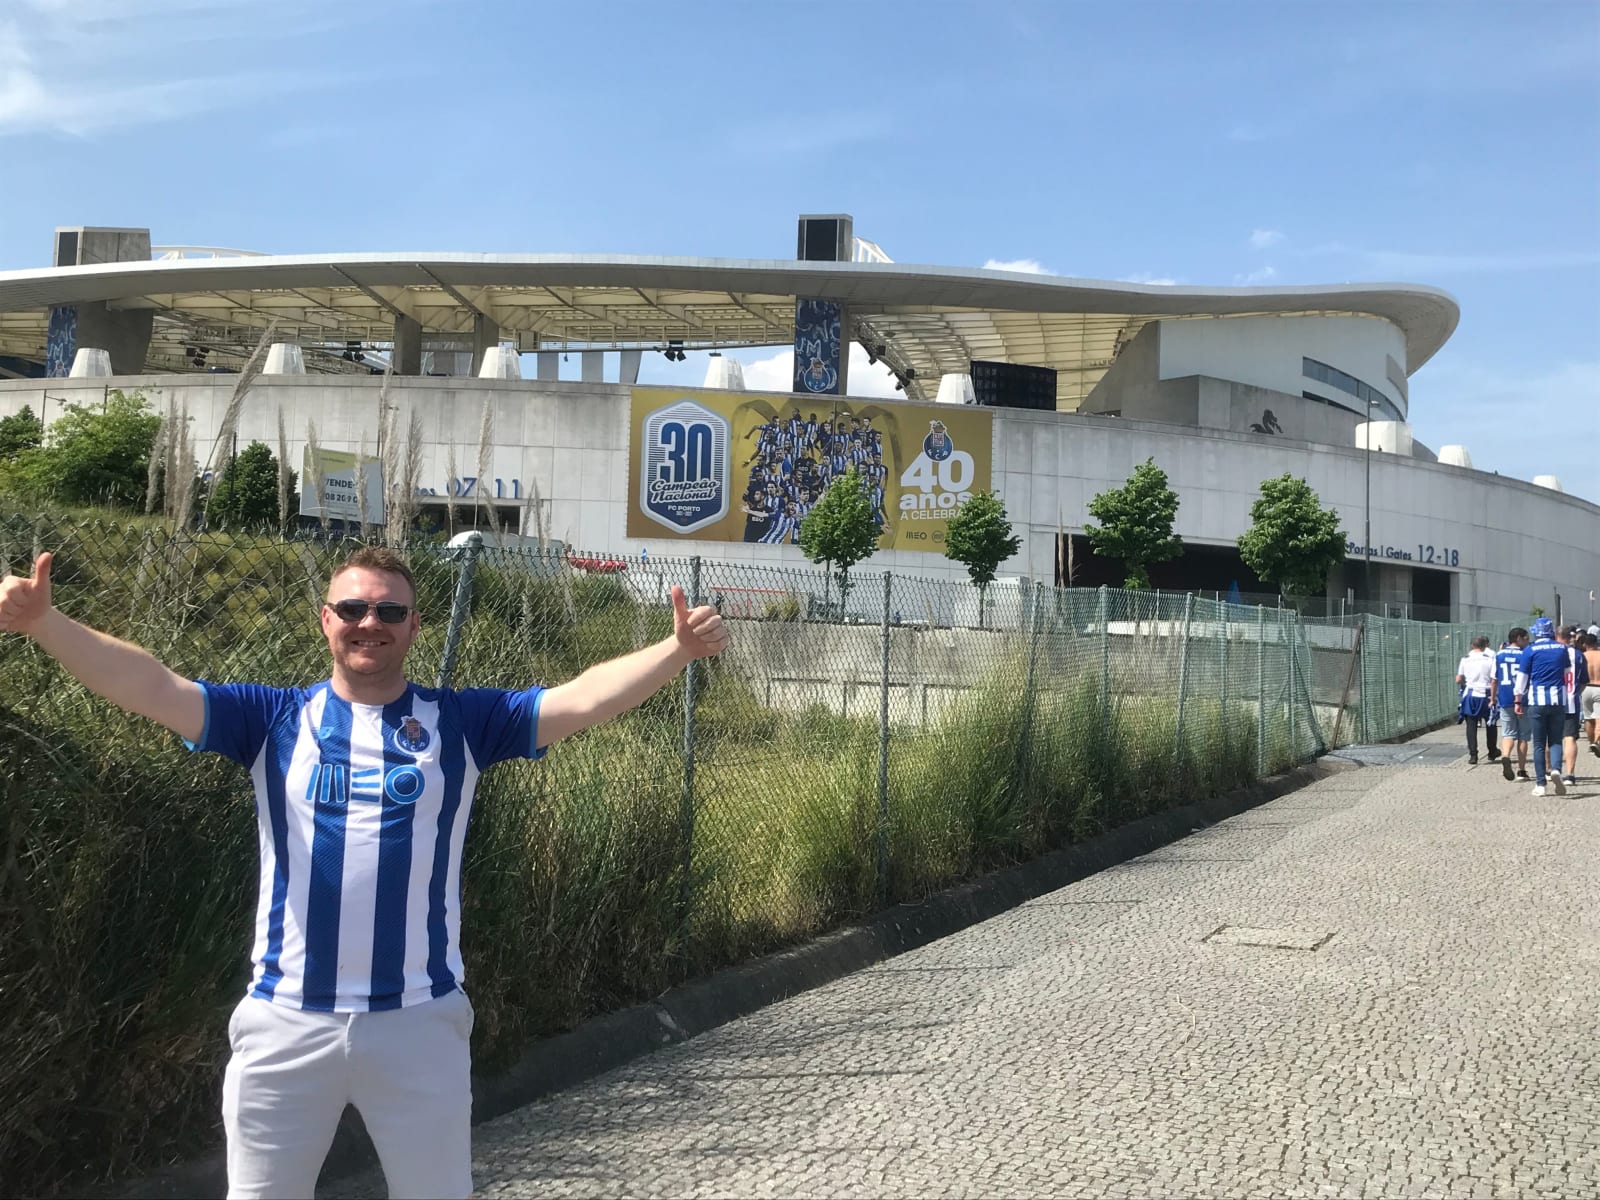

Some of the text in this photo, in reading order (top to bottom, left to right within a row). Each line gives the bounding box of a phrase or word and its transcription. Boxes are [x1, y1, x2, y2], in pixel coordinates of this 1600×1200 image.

[660, 422, 712, 482] 30
[900, 450, 975, 493] 40
[651, 478, 720, 493] Campeão
[651, 488, 716, 503] Nacional
[899, 491, 975, 510] anos
[900, 511, 909, 520] A
[905, 531, 928, 541] MEO
[1349, 542, 1378, 556] Poras
[1386, 546, 1412, 560] Gates
[1418, 544, 1459, 567] 12-18
[305, 763, 426, 804] MEO
